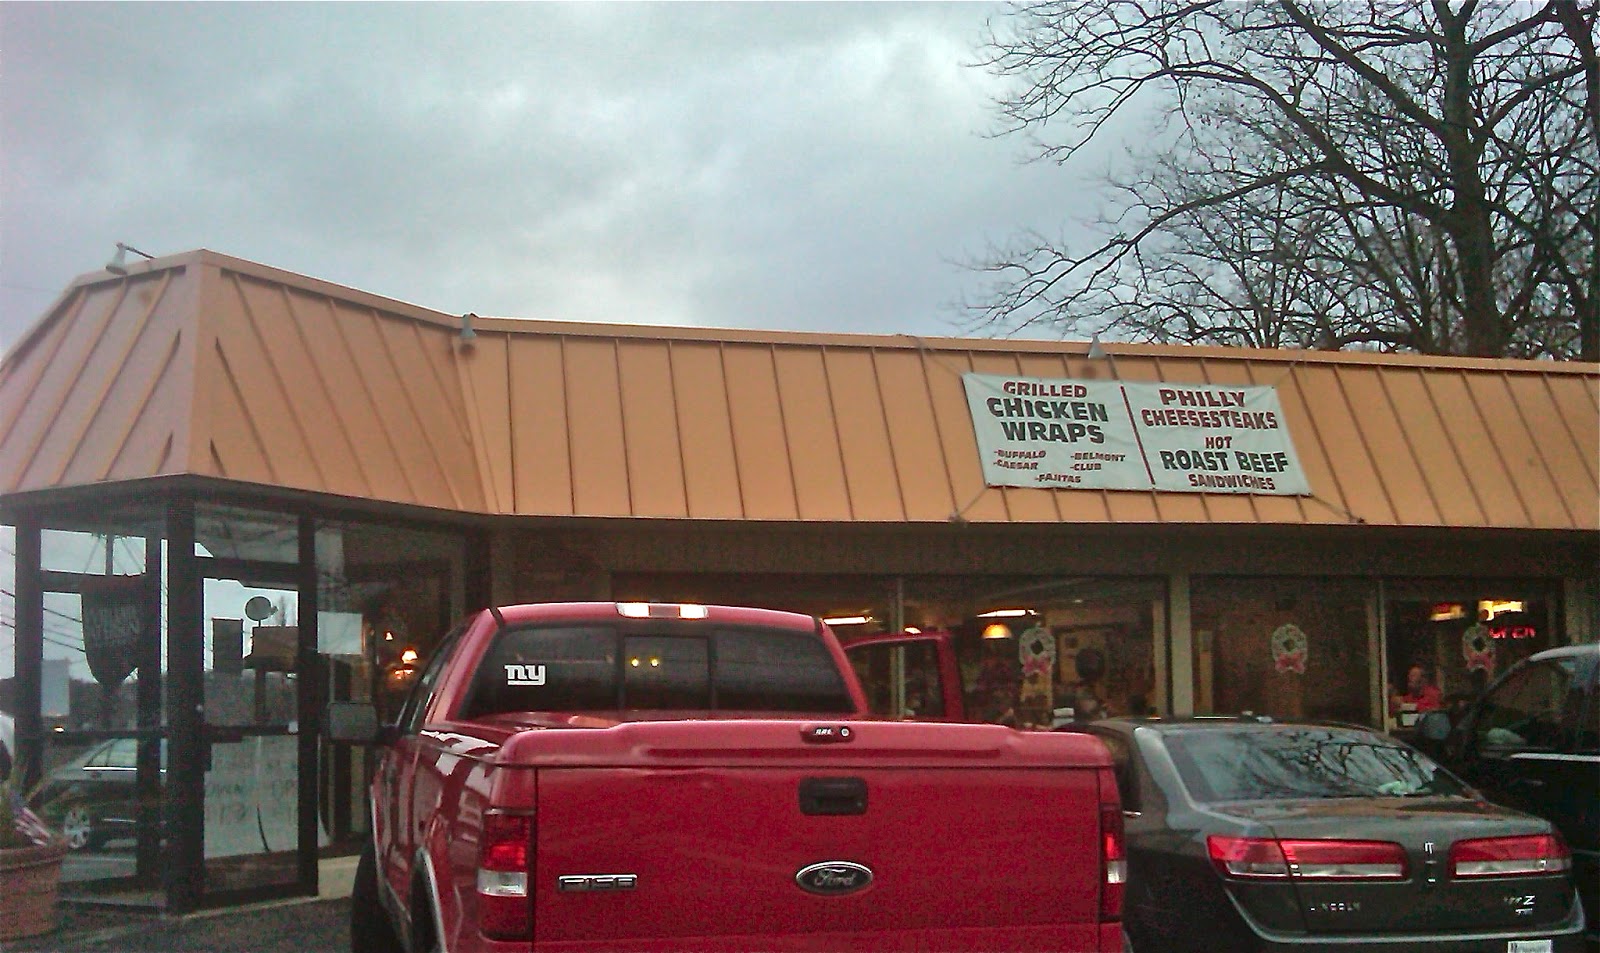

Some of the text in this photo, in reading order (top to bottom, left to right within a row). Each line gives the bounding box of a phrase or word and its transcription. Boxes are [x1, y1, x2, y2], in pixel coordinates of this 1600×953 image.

[1003, 381, 1088, 398] GRILLED
[1158, 389, 1246, 408] PHILLY
[986, 397, 1109, 422] CHICKEN
[1141, 409, 1278, 430] CHEESESTEAKS
[1000, 421, 1105, 444] WRAPS
[1205, 436, 1233, 449] HOT
[1159, 450, 1289, 473] ROAST BEEF
[1188, 473, 1276, 490] SANDWICHES
